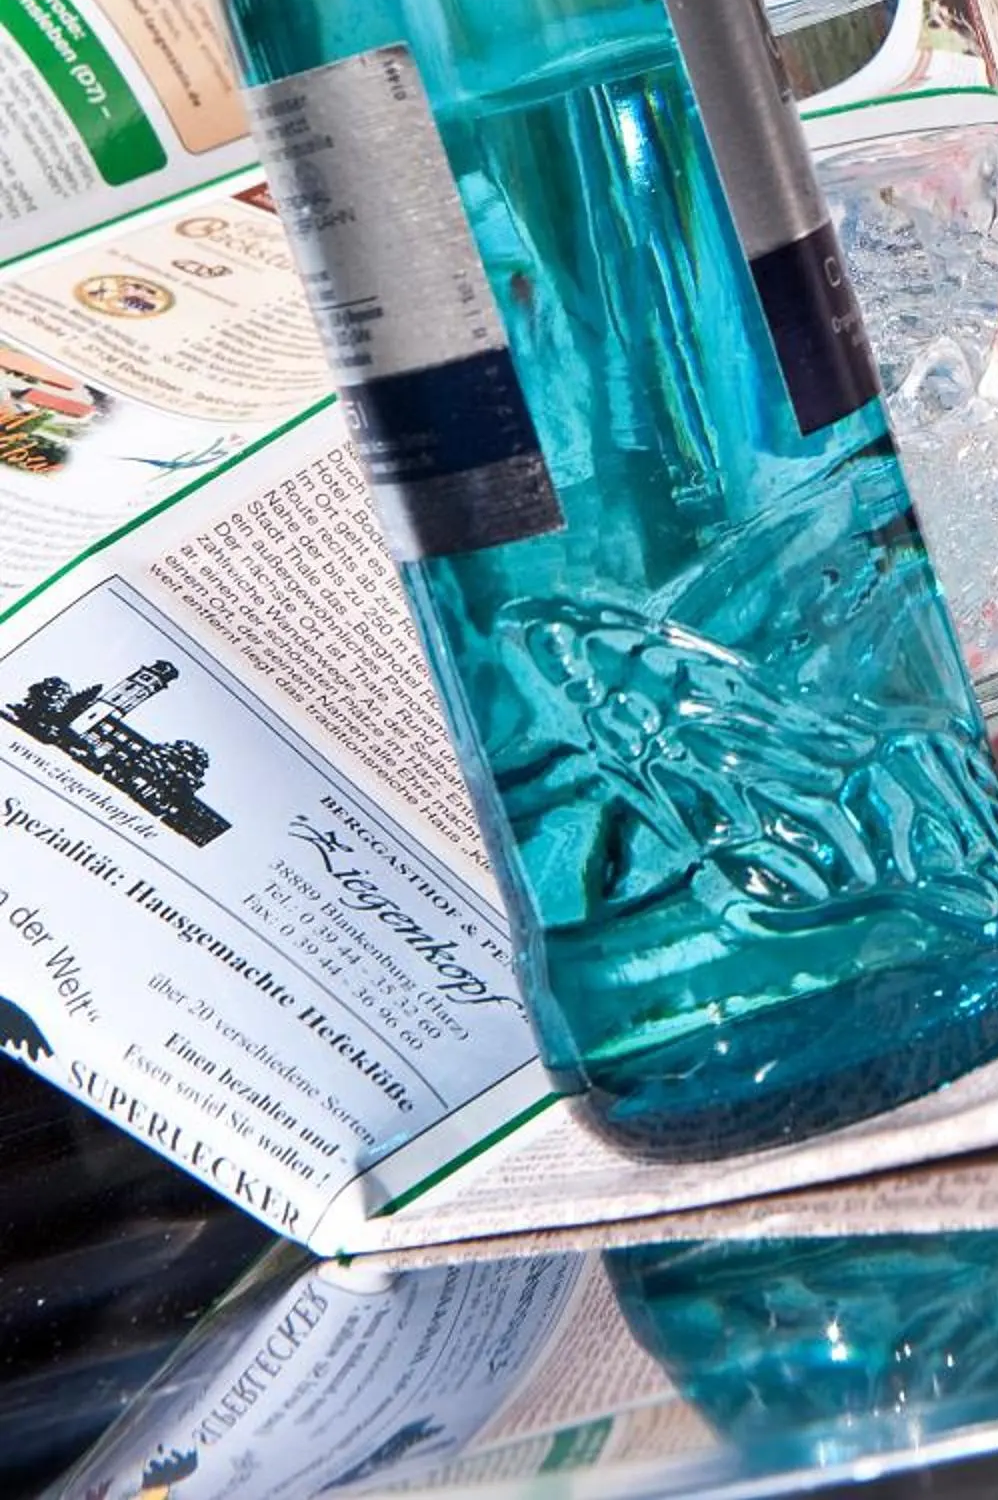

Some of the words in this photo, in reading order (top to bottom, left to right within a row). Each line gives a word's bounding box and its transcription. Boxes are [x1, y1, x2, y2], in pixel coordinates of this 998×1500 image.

[69, 63, 107, 104] (D7)
[295, 468, 316, 493] Im
[314, 493, 340, 521] Ort
[336, 521, 369, 557] geht
[367, 557, 387, 577] es
[311, 459, 352, 503] Hotel
[326, 448, 366, 496] Durch
[231, 513, 255, 538] ein
[251, 539, 382, 675] außergewöhnliches
[247, 500, 286, 545] Stadt
[283, 541, 321, 587] Thale
[319, 587, 348, 617] das
[279, 479, 319, 527] Route
[315, 526, 359, 573] rechts
[355, 573, 377, 593] ab
[374, 594, 400, 617] zur
[298, 535, 326, 560] der
[321, 560, 347, 587] bis
[343, 587, 364, 608] zu
[361, 606, 395, 637] 250
[389, 637, 409, 655] m
[149, 563, 184, 593] weit
[181, 594, 242, 645] entfernt
[239, 645, 276, 676] liegt
[275, 677, 305, 703] das
[305, 703, 419, 805] traditionsreiche
[419, 805, 461, 844] Haus
[164, 555, 209, 597] einem
[208, 597, 236, 624] Ort,
[236, 624, 265, 645] der
[262, 647, 317, 695] seinem
[315, 694, 370, 743] Namen
[368, 743, 397, 767] alle
[395, 766, 433, 799] Ehre
[431, 799, 481, 842] macht
[195, 533, 265, 607] zahlreiche
[265, 604, 357, 693] Wanderwege.
[359, 698, 383, 717] An
[383, 717, 411, 739] der
[199, 565, 240, 605] einen
[238, 604, 266, 627] der
[263, 628, 340, 697] schönsten
[337, 695, 385, 737] Plätze
[383, 737, 406, 757] im
[404, 755, 442, 793] Harz.
[213, 520, 243, 551] Der
[240, 555, 297, 614] nächste
[298, 615, 326, 641] Ort
[325, 641, 348, 662] ist
[349, 661, 389, 707] Thale.
[394, 707, 440, 747] Rund
[8, 741, 159, 839] www.ziegenkopf.de
[9, 907, 54, 947] der
[319, 795, 463, 917] BERGGASTHOF
[460, 923, 478, 938] &
[3, 798, 125, 887] Spezialität:
[125, 879, 295, 1007] Hausgemachte
[297, 1005, 413, 1111] Hefeklöße
[242, 893, 279, 925] Fax:
[279, 923, 296, 937] 0
[293, 937, 320, 955] 39
[318, 958, 344, 976] 44
[351, 986, 376, 1008] 36
[379, 1007, 399, 1029] 96
[399, 1029, 424, 1051] 60
[269, 859, 322, 901] 38889
[319, 901, 417, 992] Blankenburg
[417, 991, 469, 1041] (Harz)
[299, 912, 316, 925] 0
[314, 925, 339, 944] 39
[337, 947, 363, 965] 44
[371, 975, 397, 996] 35
[392, 995, 420, 1017] 32
[417, 1018, 442, 1040] 60
[122, 1043, 173, 1086] Essen
[177, 1081, 228, 1120] soviel
[230, 1110, 254, 1137] Sie
[257, 1134, 315, 1180] wollen
[147, 975, 188, 1006] über
[187, 999, 215, 1021] 20
[215, 1018, 321, 1098] verschiedene
[320, 1095, 376, 1150] Sorten
[164, 1032, 217, 1076] Einen
[217, 1067, 298, 1130] bezahlen
[299, 1127, 340, 1157] und
[71, 1060, 300, 1233] SUPERLECKER
